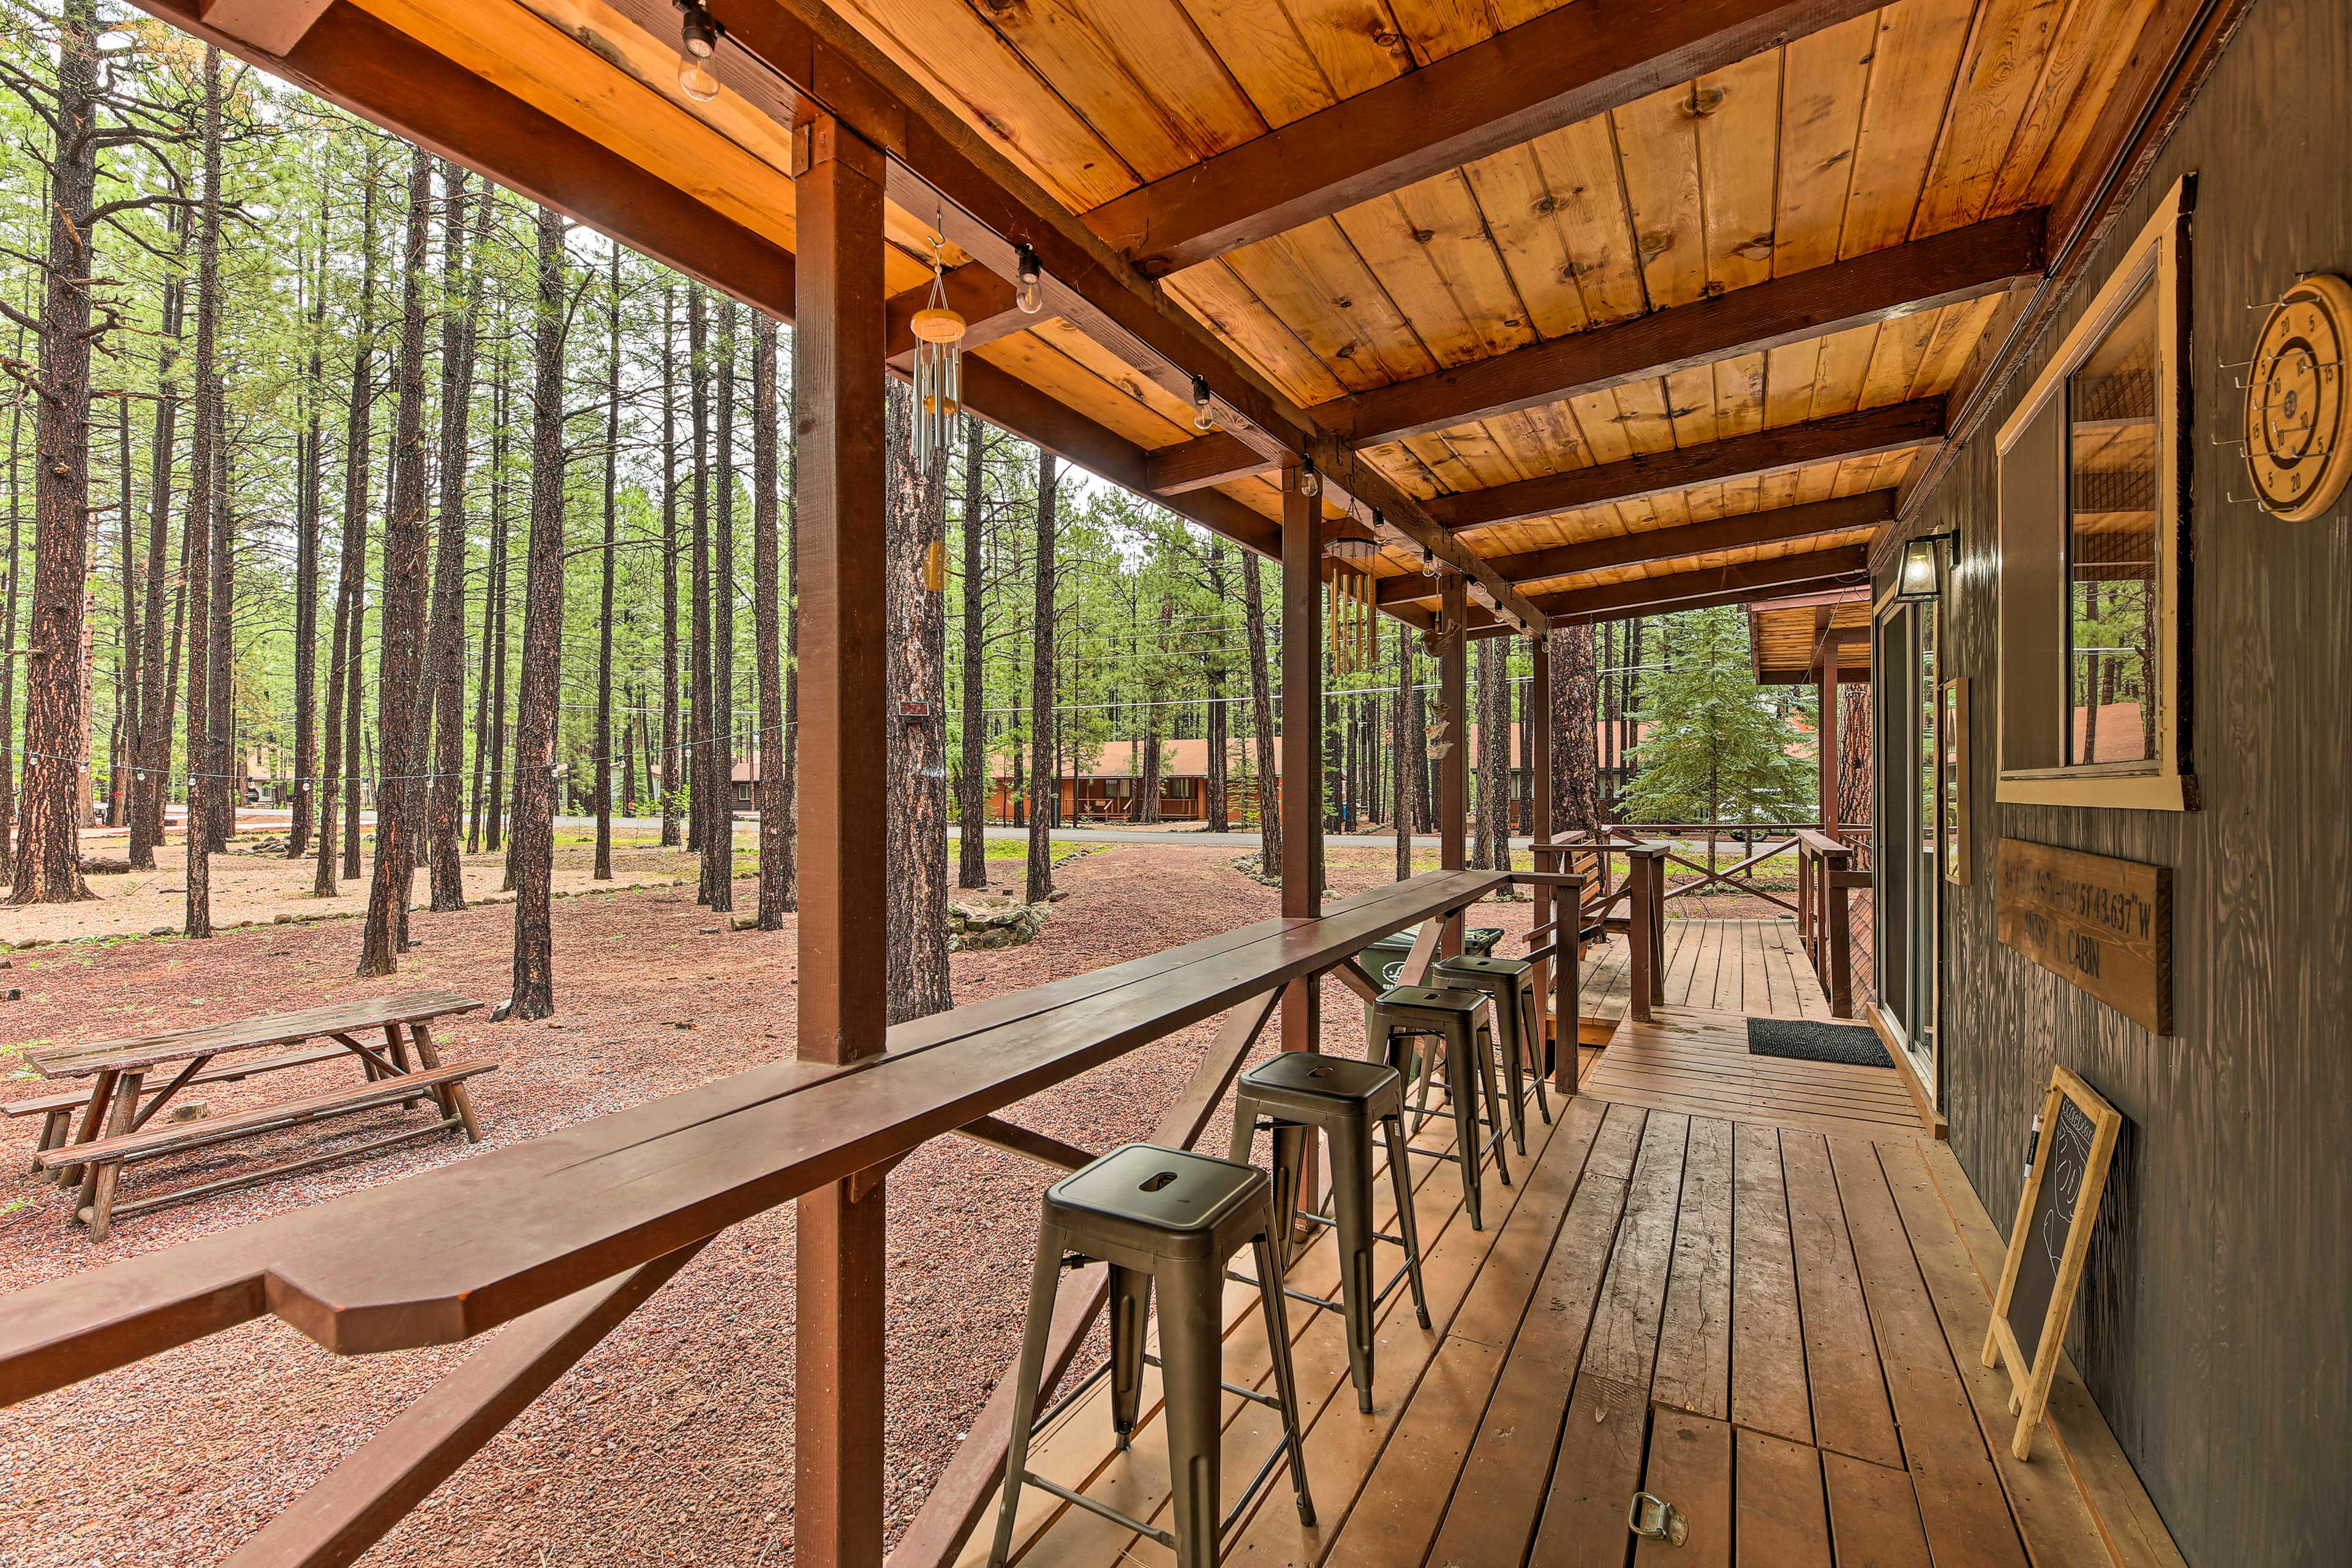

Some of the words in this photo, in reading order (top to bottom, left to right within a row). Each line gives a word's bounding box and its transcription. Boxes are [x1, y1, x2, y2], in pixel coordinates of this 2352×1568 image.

[2280, 316, 2290, 337] 20
[2309, 314, 2315, 331] 5
[2261, 359, 2266, 375] 5
[2274, 377, 2281, 396] 10
[2300, 411, 2308, 429] 10
[2253, 423, 2260, 440] 15
[2277, 429, 2285, 448] 10
[2318, 437, 2323, 454] 5
[2268, 471, 2273, 488] 5
[2291, 472, 2301, 493] 20
[2068, 929, 2100, 979] CABIN
